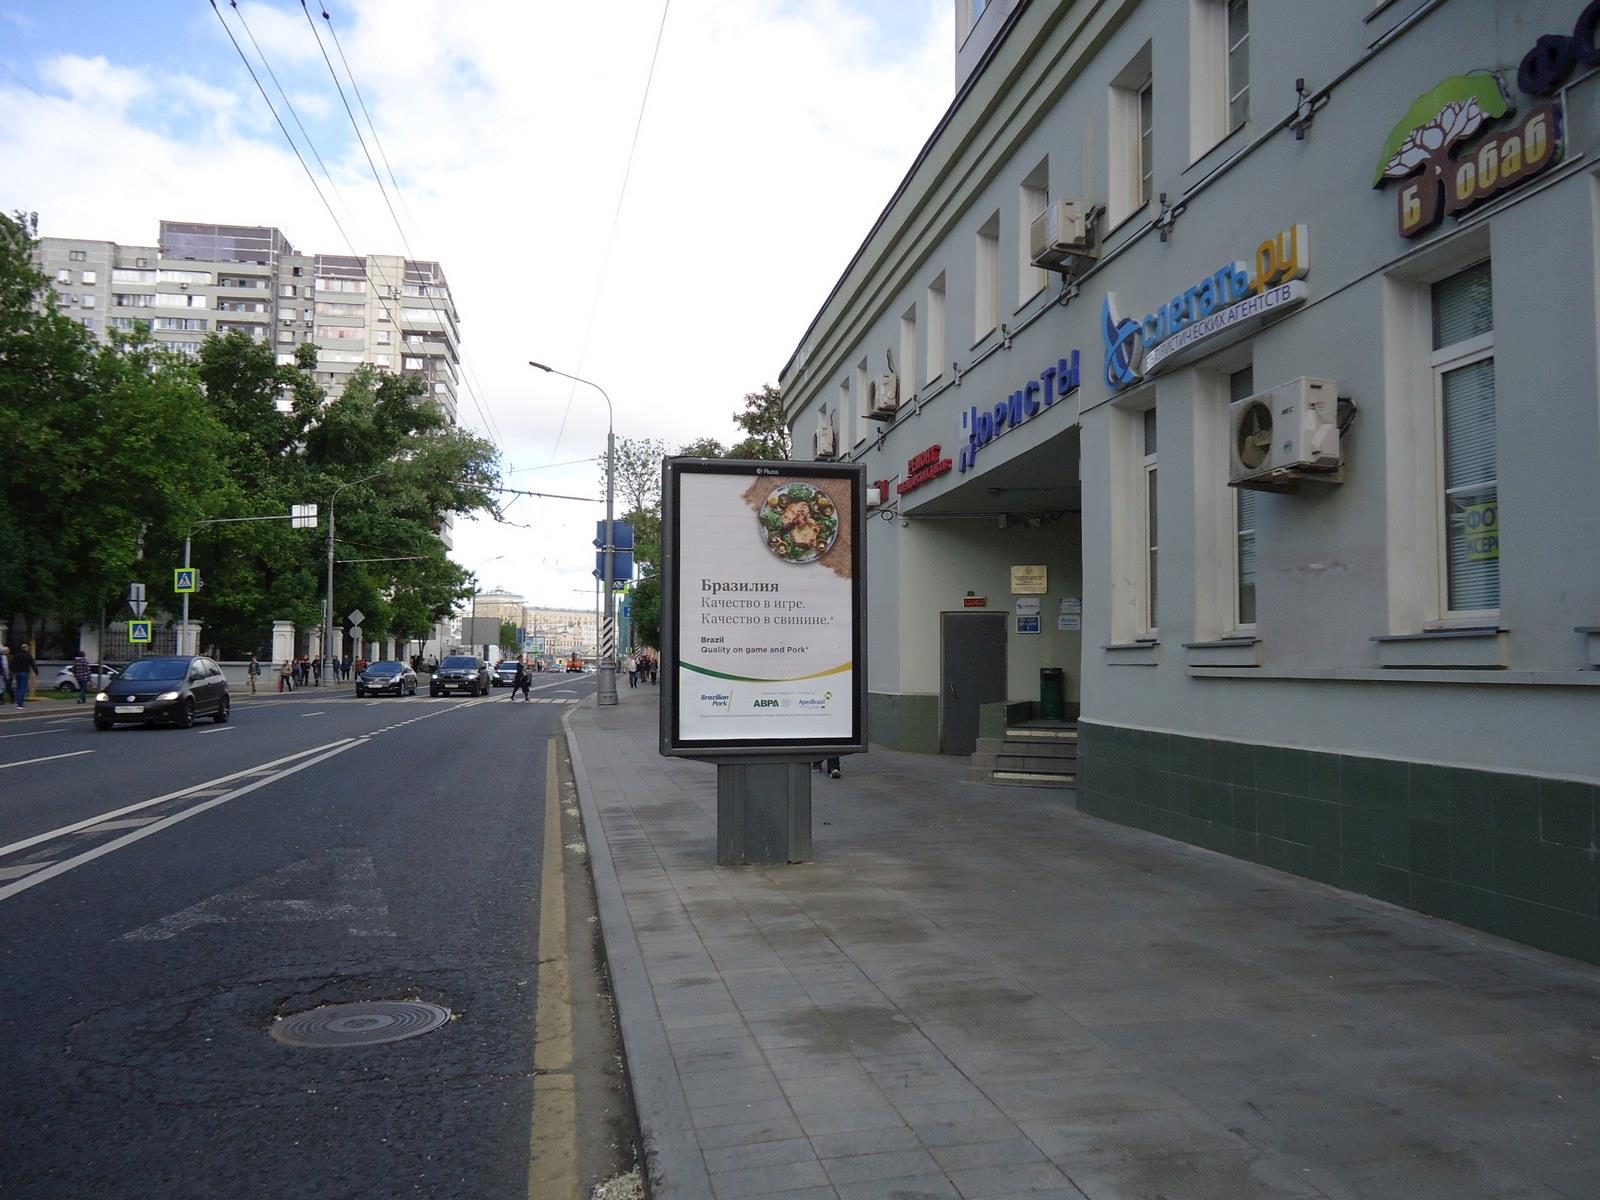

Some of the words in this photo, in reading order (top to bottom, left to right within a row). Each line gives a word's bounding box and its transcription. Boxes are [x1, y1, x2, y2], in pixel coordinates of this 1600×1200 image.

[1228, 285, 1292, 322] АГЕНТСТВ
[701, 578, 779, 594] Бразилия
[701, 596, 761, 609] Качество
[763, 600, 771, 608] в
[773, 600, 806, 611] игре.
[701, 613, 761, 625] Качество
[763, 616, 771, 625] в
[700, 646, 731, 654] Quality
[769, 646, 785, 654] and
